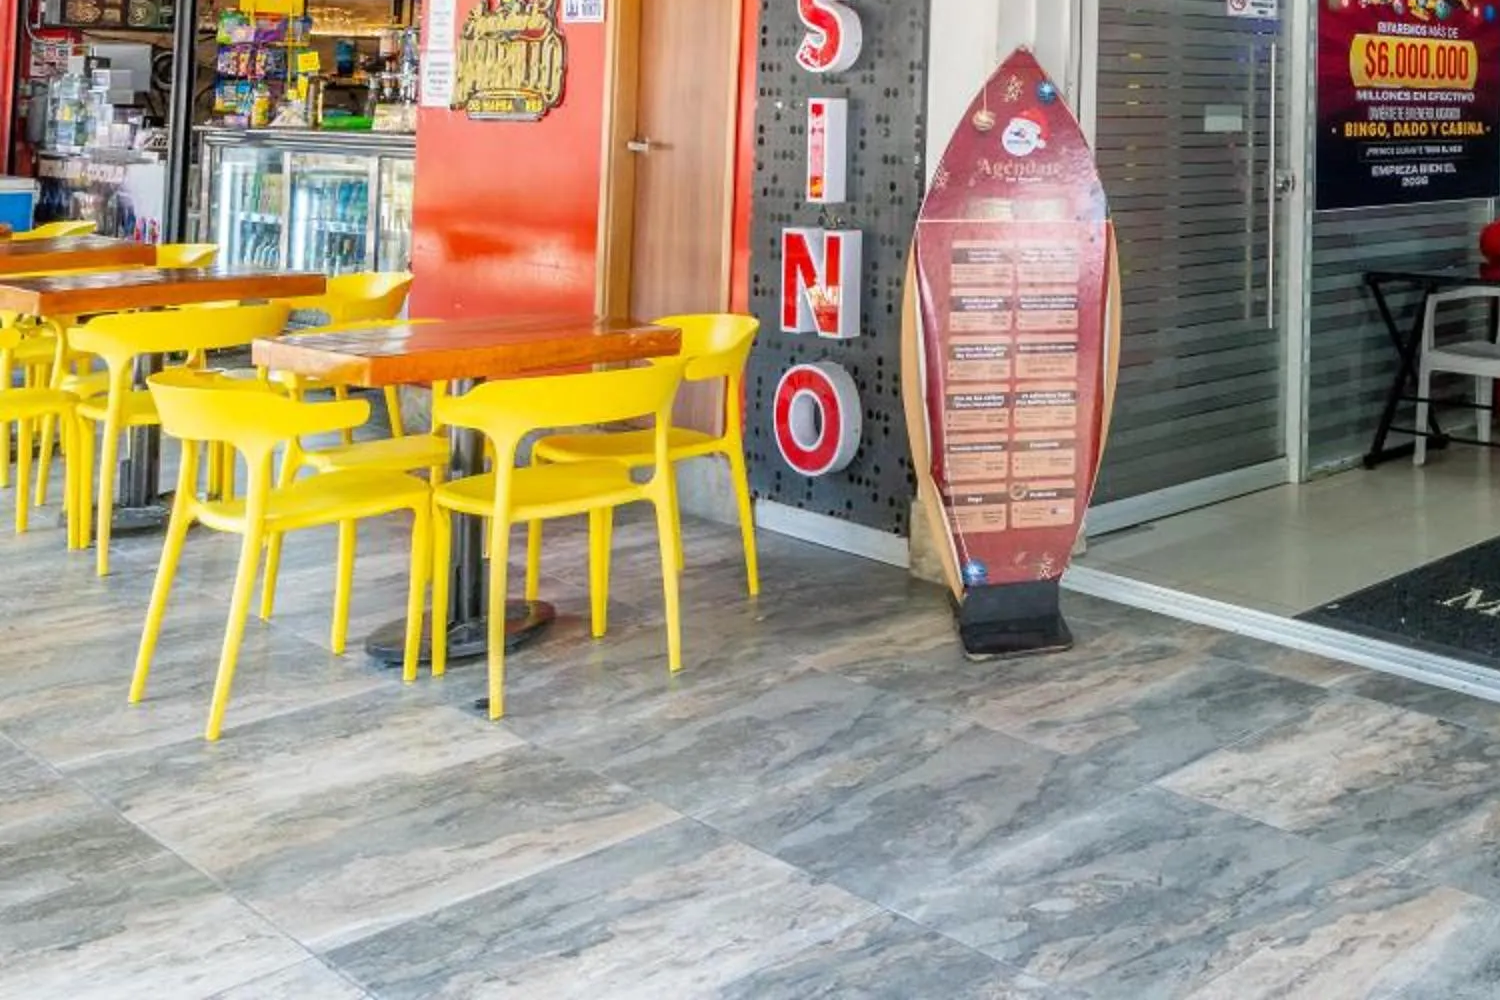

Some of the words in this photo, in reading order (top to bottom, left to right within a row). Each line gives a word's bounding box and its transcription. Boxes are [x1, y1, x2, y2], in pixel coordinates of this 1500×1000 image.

[1365, 39, 1469, 80] $6.000.000
[1356, 89, 1411, 101] MILLONES
[1413, 91, 1427, 101] EN
[1428, 91, 1475, 103] EFECTIVO
[1344, 121, 1391, 138] BINGO,
[1393, 121, 1428, 137] DADO
[1371, 164, 1418, 177] EMPIEZA
